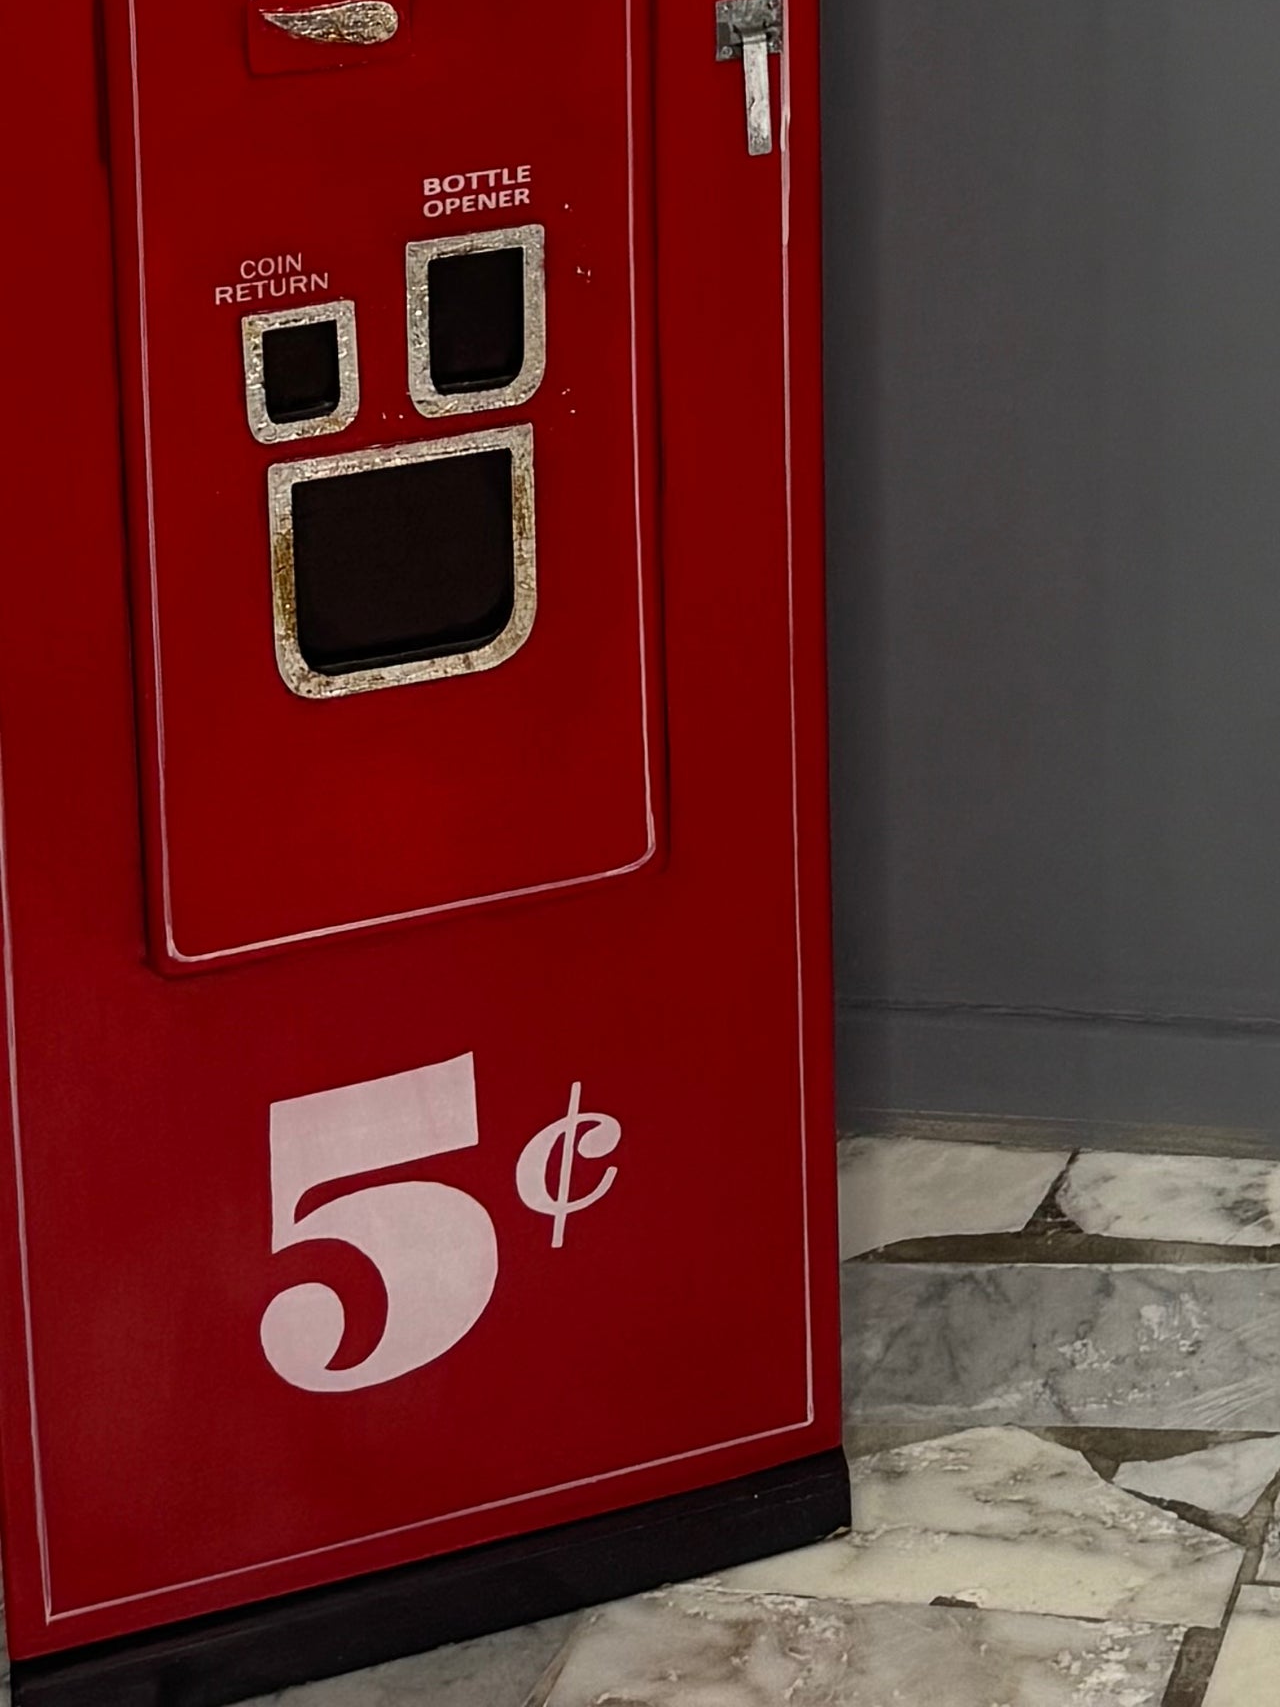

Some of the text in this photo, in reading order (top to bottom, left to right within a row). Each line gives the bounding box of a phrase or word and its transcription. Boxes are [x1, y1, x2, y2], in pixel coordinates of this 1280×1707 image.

[423, 164, 532, 197] BOTTLE
[422, 187, 531, 219] OPENER
[239, 251, 303, 280] COIN
[214, 271, 330, 306] RETURN
[258, 1050, 623, 1395] 5¢
